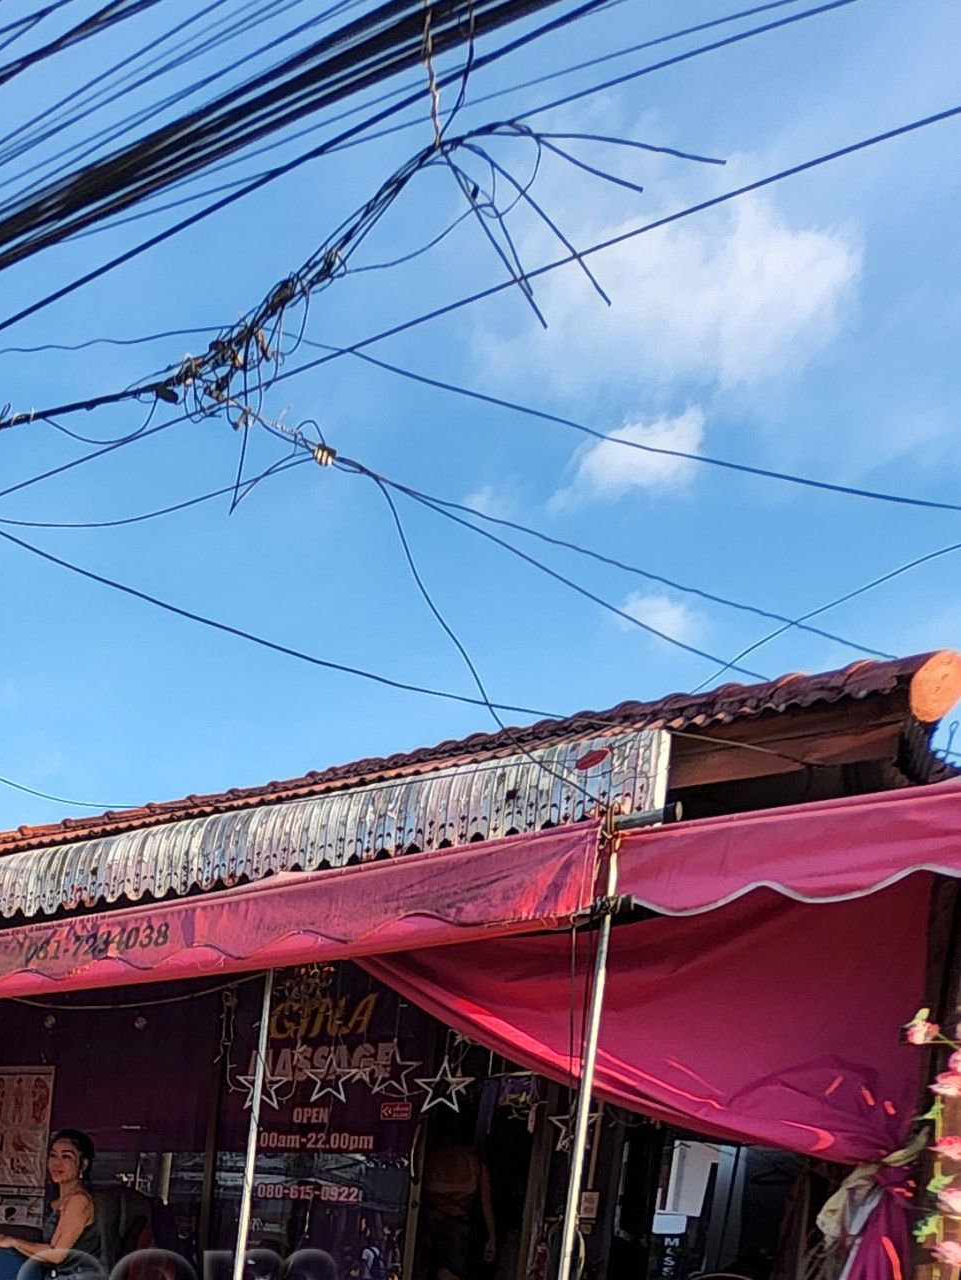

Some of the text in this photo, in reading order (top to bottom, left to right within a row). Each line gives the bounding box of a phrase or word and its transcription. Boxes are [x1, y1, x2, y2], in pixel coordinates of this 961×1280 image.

[269, 992, 379, 1039] GINA
[292, 1107, 329, 1124] OPEN
[257, 1132, 374, 1150] 00am-22.00pm
